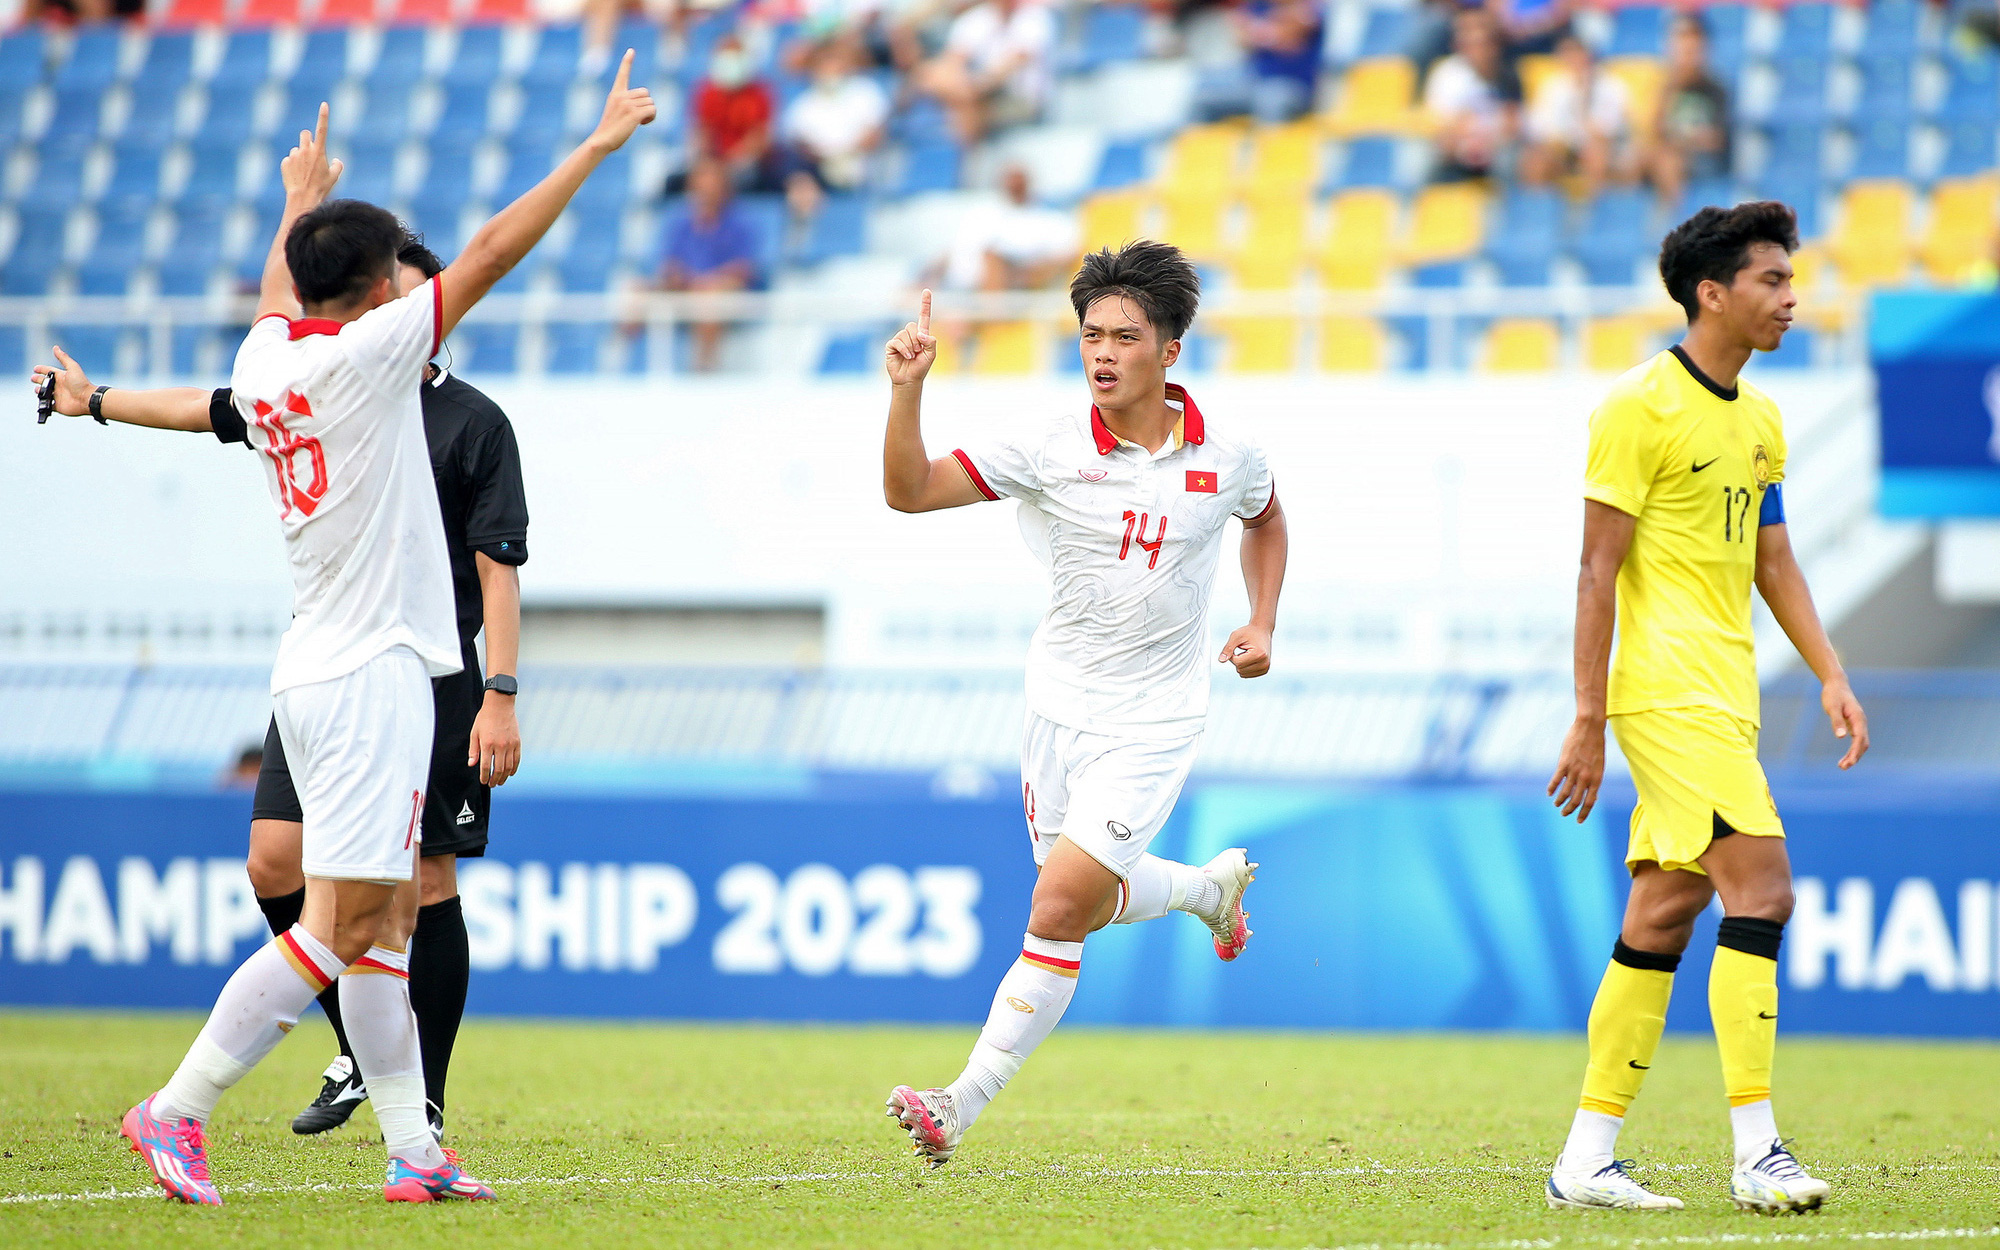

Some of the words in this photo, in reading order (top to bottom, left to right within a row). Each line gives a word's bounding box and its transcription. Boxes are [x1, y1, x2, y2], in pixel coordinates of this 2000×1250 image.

[249, 389, 329, 521] 16
[1118, 509, 1168, 570] 14
[1724, 486, 1751, 544] 17
[403, 788, 426, 851] 1
[456, 815, 475, 826] SELECT
[712, 862, 984, 978] 2023
[1710, 876, 2000, 992] HAI
